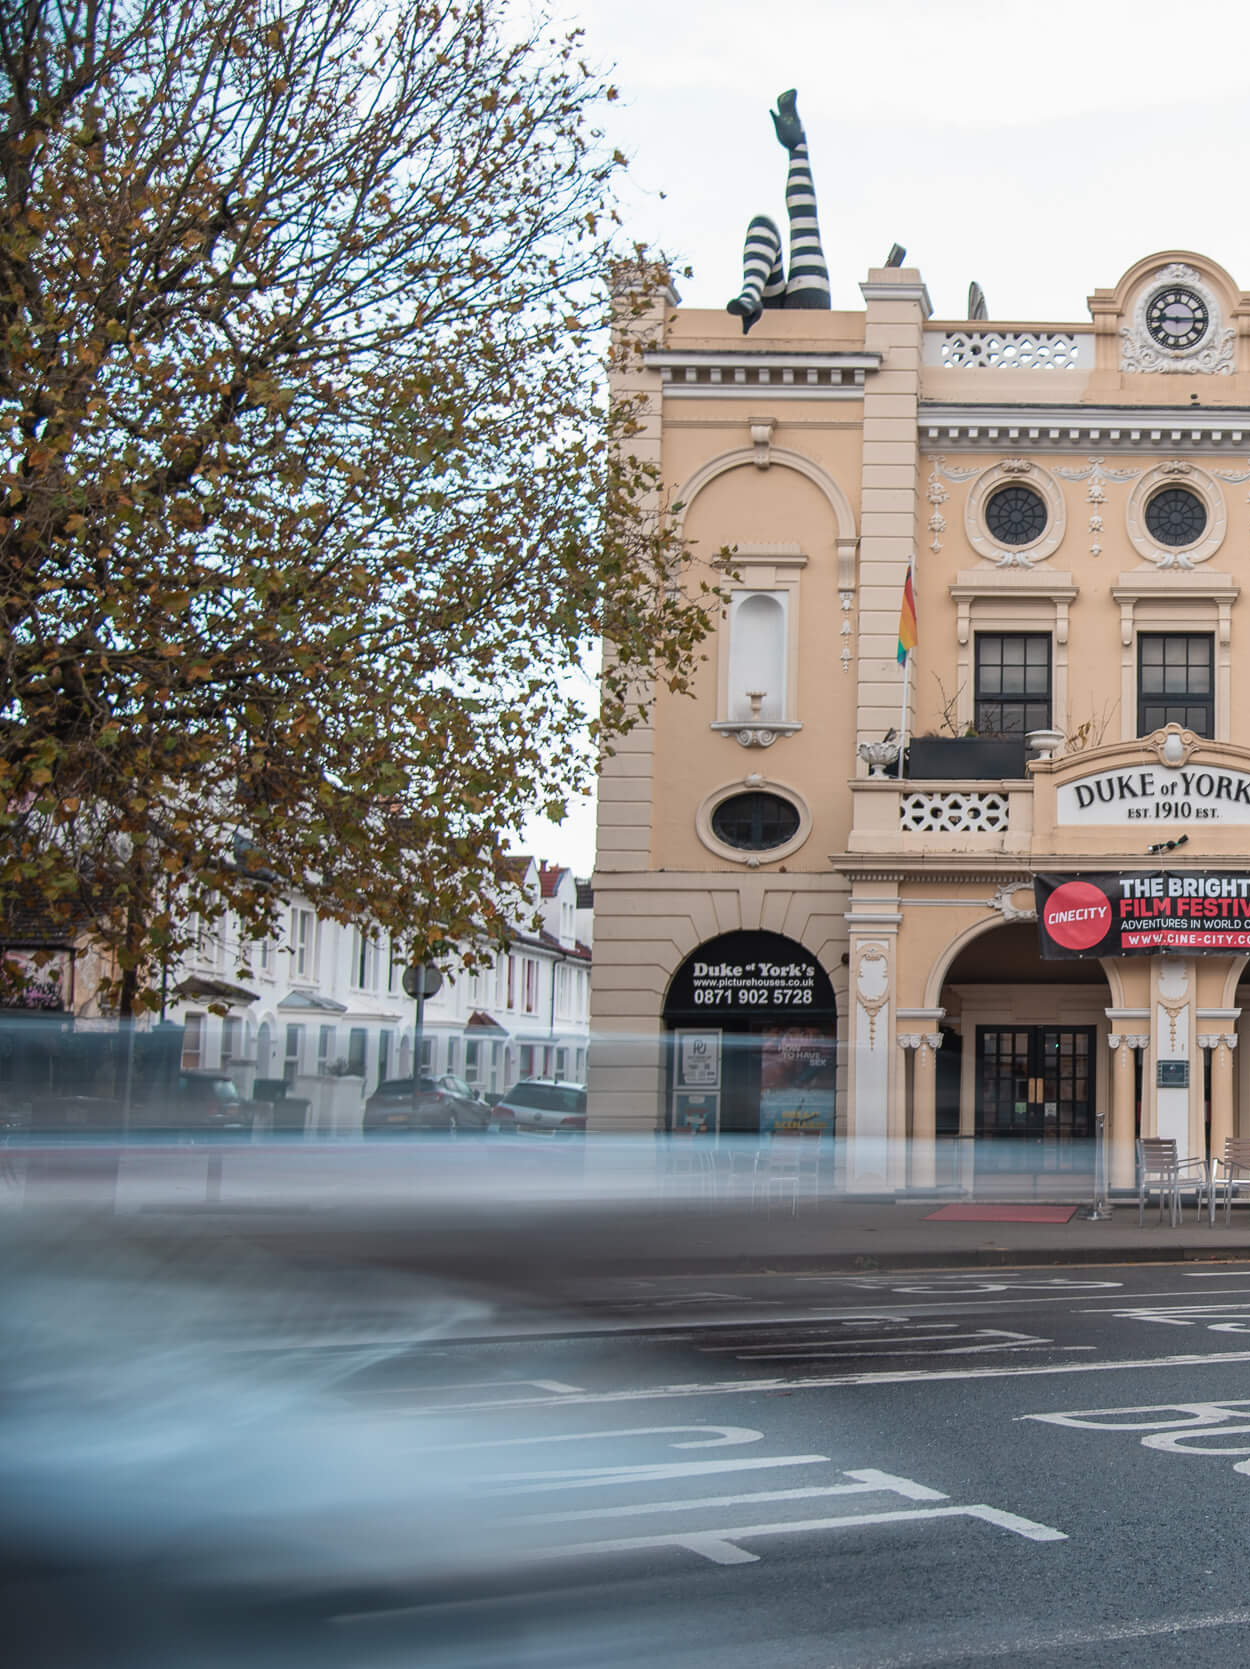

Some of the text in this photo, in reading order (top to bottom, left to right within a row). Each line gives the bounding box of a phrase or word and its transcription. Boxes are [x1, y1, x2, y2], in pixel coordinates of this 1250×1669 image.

[1074, 773, 1155, 809] DUKE
[1160, 781, 1178, 796] of
[1127, 801, 1219, 819] EST. 1910 EST.
[1119, 879, 1164, 898] THE
[1048, 906, 1107, 925] CINECITY
[1119, 898, 1170, 918] FILM
[1121, 919, 1188, 930] ADVENTURES
[1190, 919, 1201, 929] IN
[1203, 919, 1242, 929] WORLD
[693, 963, 815, 977] Duke of York's
[694, 978, 814, 988] www.picturehouses.co.uk
[694, 989, 813, 1004] 0871 902 5728
